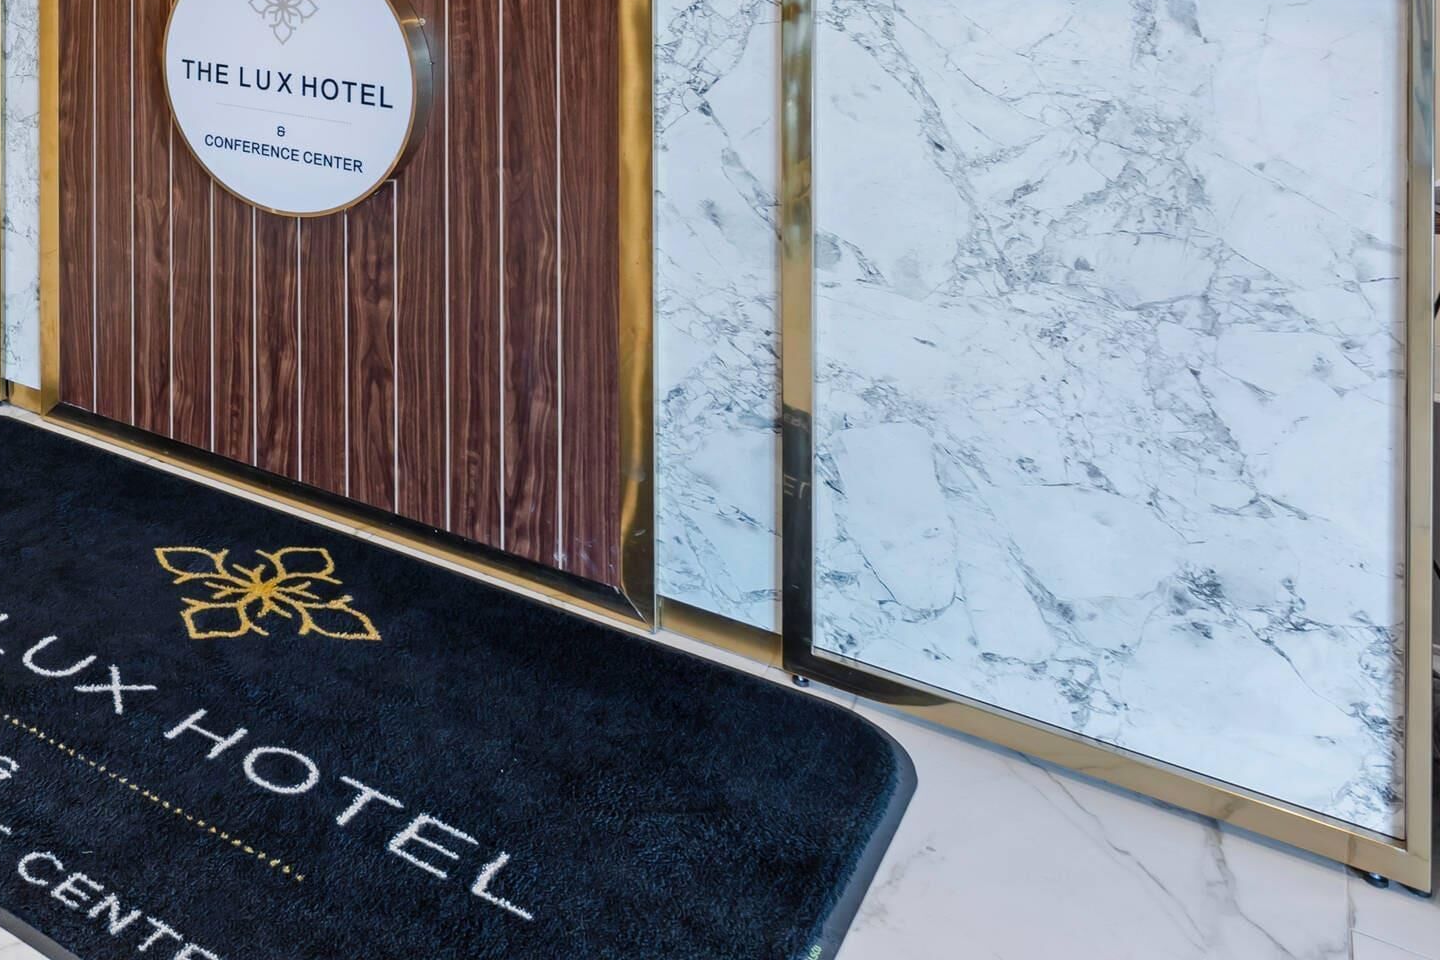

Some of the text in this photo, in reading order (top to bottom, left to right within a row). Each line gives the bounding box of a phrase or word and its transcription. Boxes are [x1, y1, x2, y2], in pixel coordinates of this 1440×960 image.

[181, 58, 394, 109] THE LUX HOTEL
[204, 134, 363, 174] CONFERENCE CENTER
[276, 125, 286, 138] &
[163, 708, 534, 920] HOTEL
